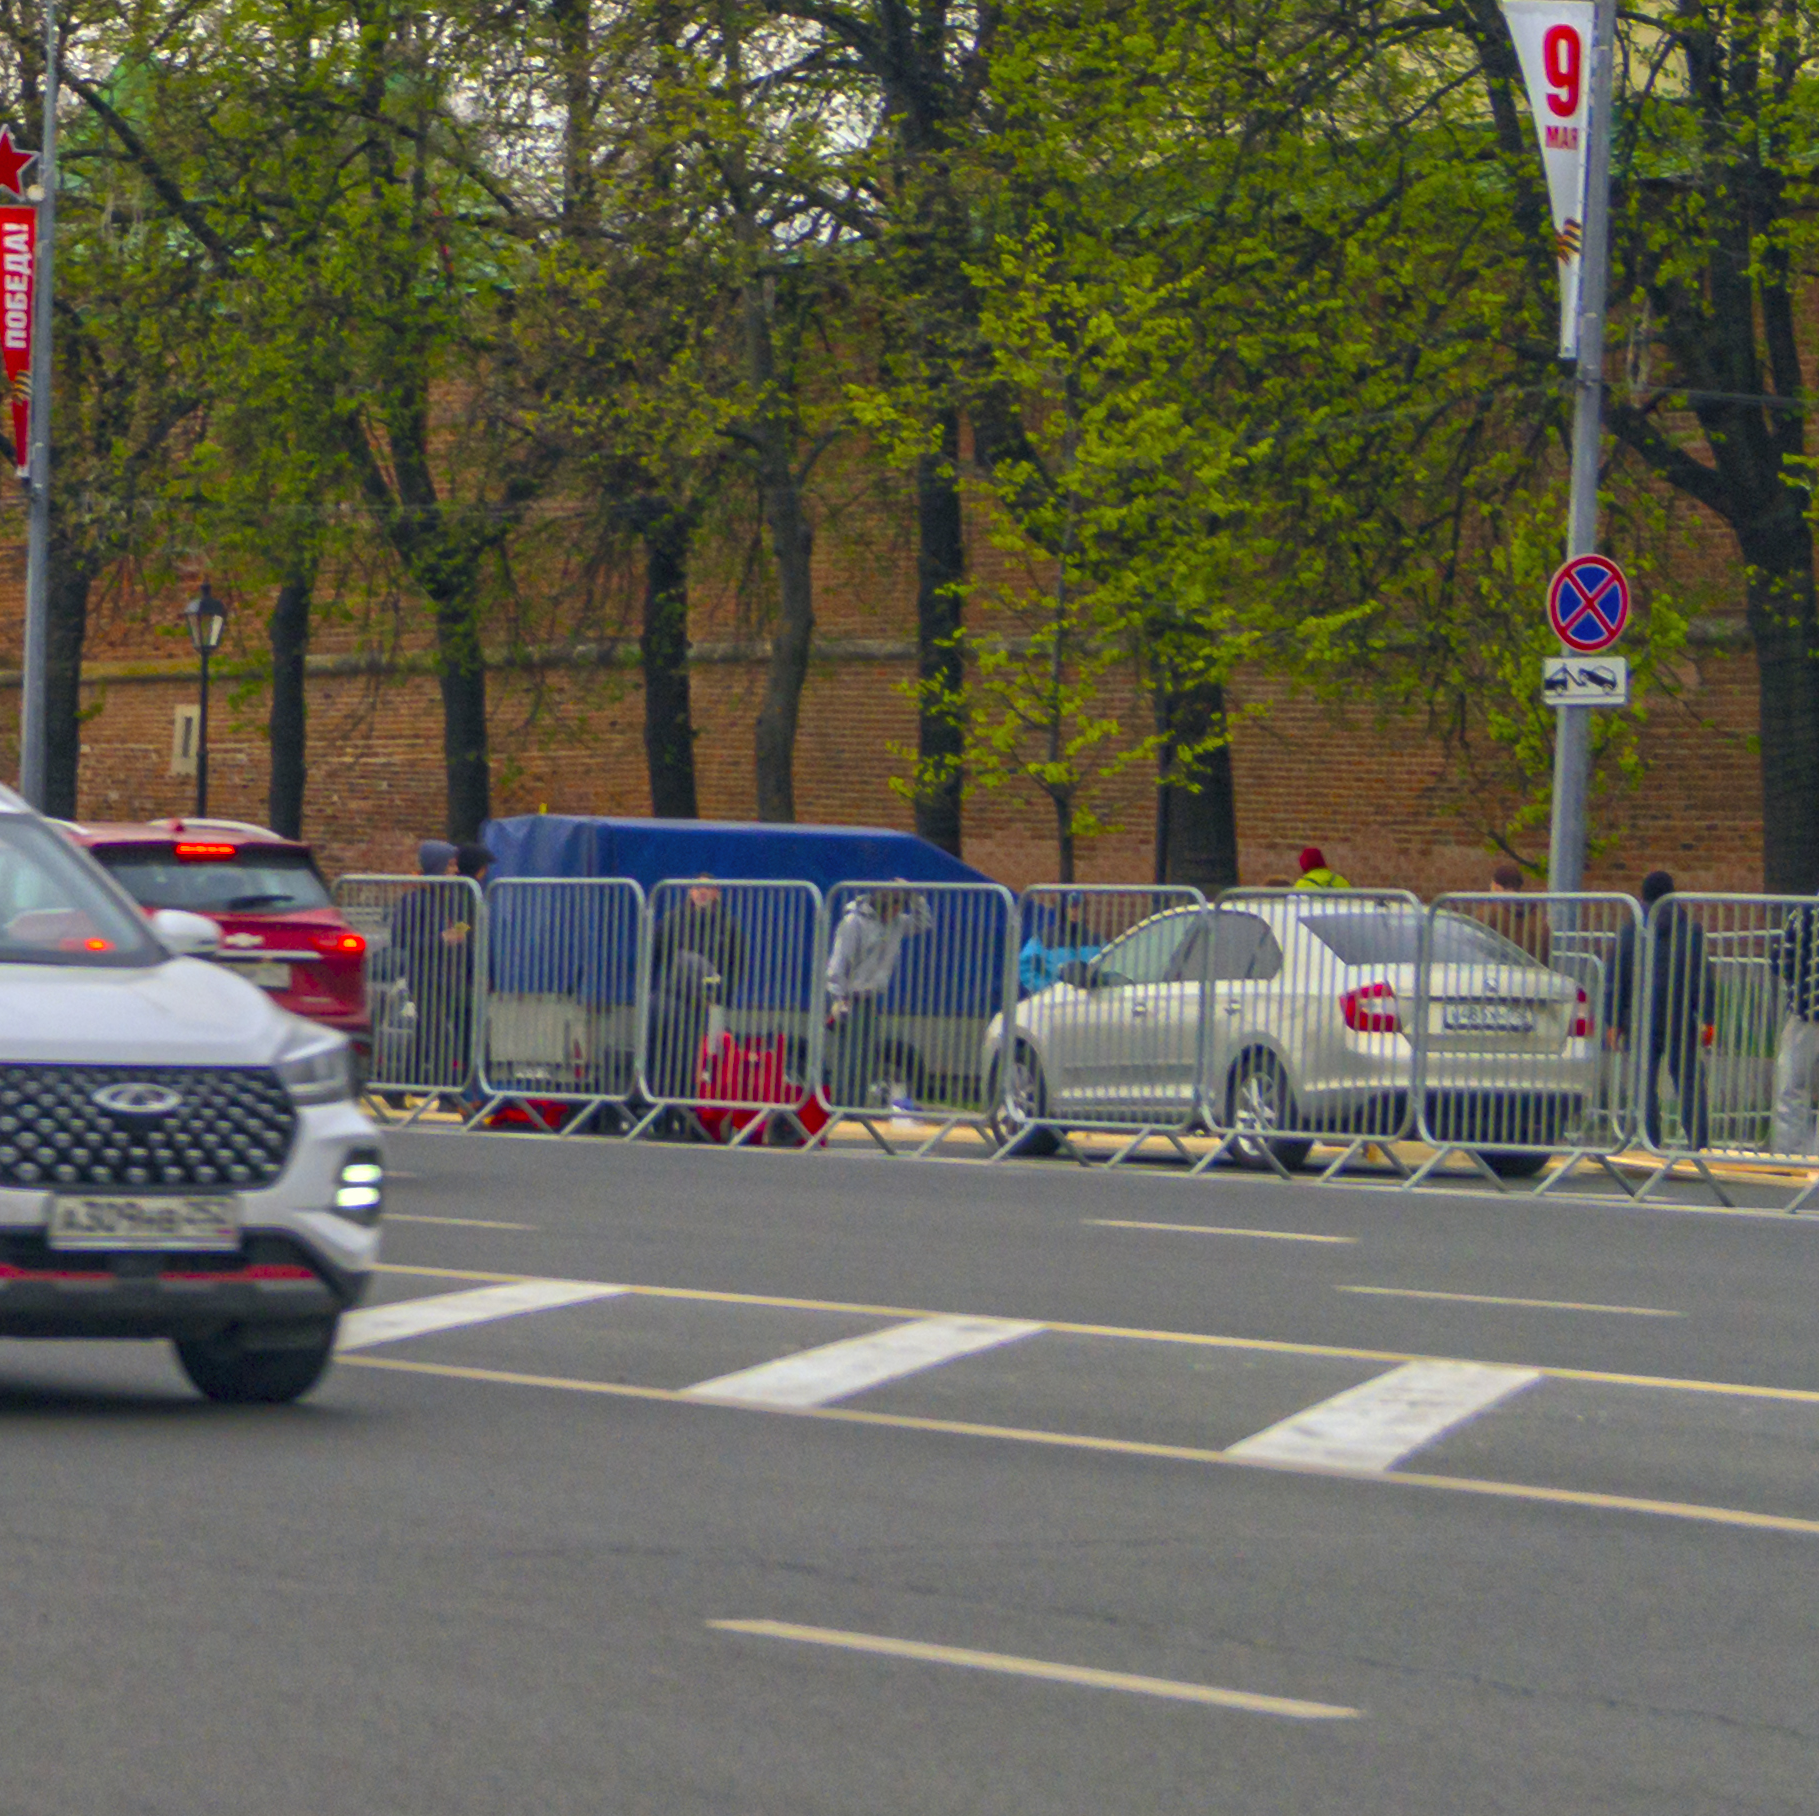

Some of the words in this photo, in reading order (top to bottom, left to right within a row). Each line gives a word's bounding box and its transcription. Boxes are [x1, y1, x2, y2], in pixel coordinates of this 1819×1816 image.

[1543, 24, 1582, 118] 9
[1545, 125, 1579, 150] МАЯ
[1, 221, 32, 349] ПОБЕДА!
